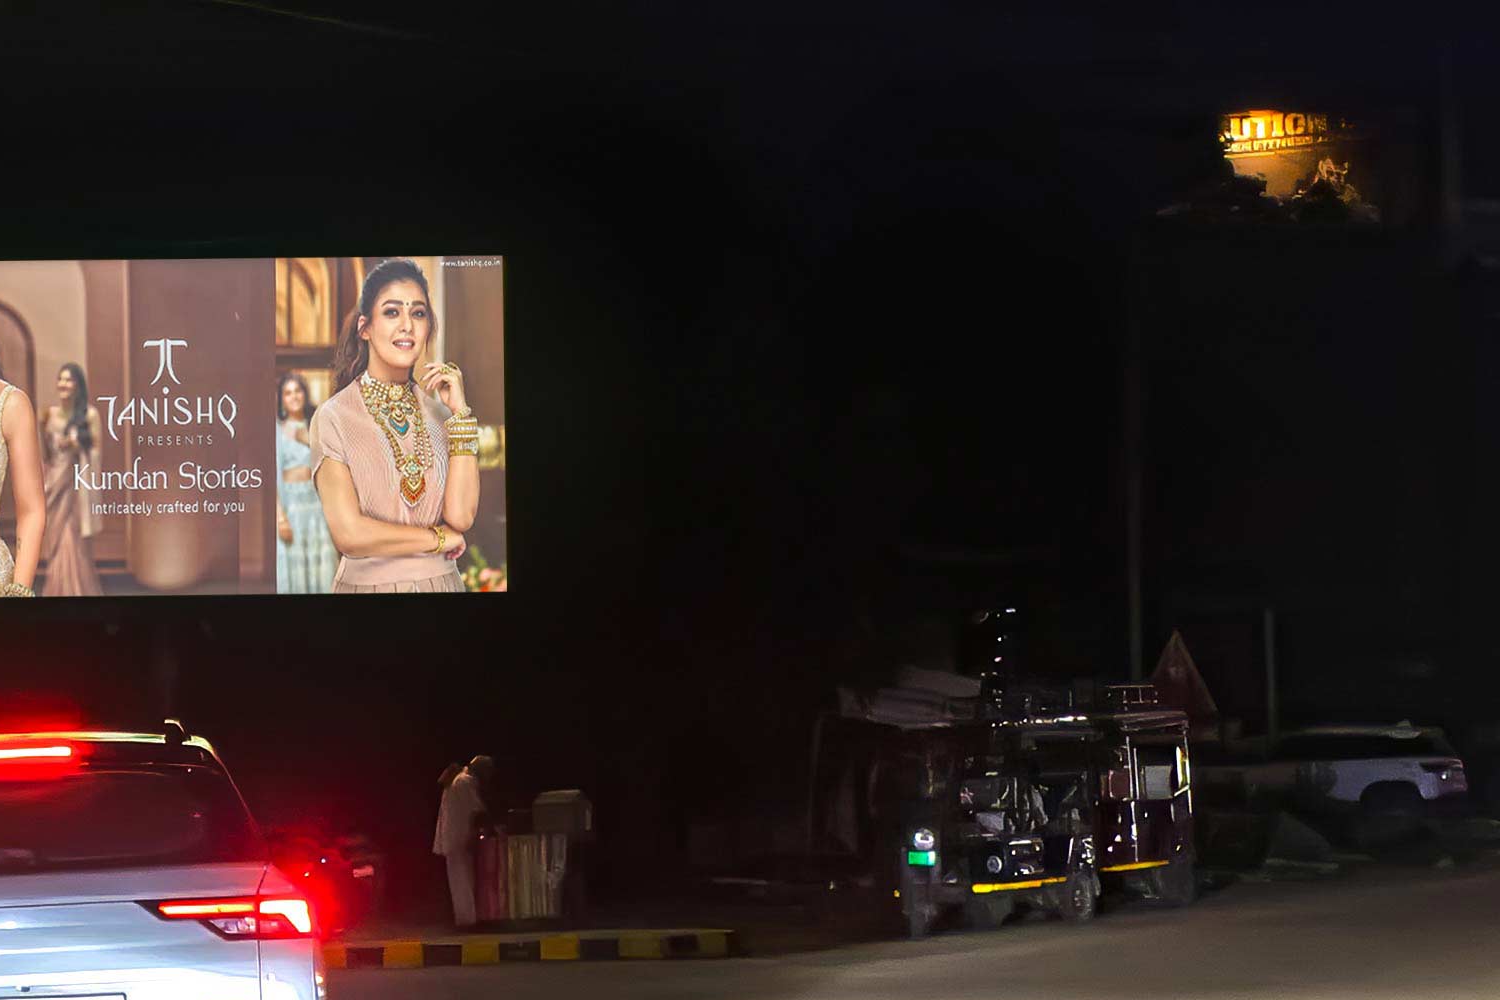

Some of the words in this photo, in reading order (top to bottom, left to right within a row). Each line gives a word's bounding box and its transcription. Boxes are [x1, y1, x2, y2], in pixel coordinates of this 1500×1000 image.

[97, 387, 237, 441] TANISHQ
[138, 435, 213, 446] PRESENTS
[74, 456, 168, 491] Kundan
[179, 461, 262, 493] Stories
[156, 500, 199, 514] crafted
[203, 500, 220, 513] for
[223, 502, 245, 515] you
